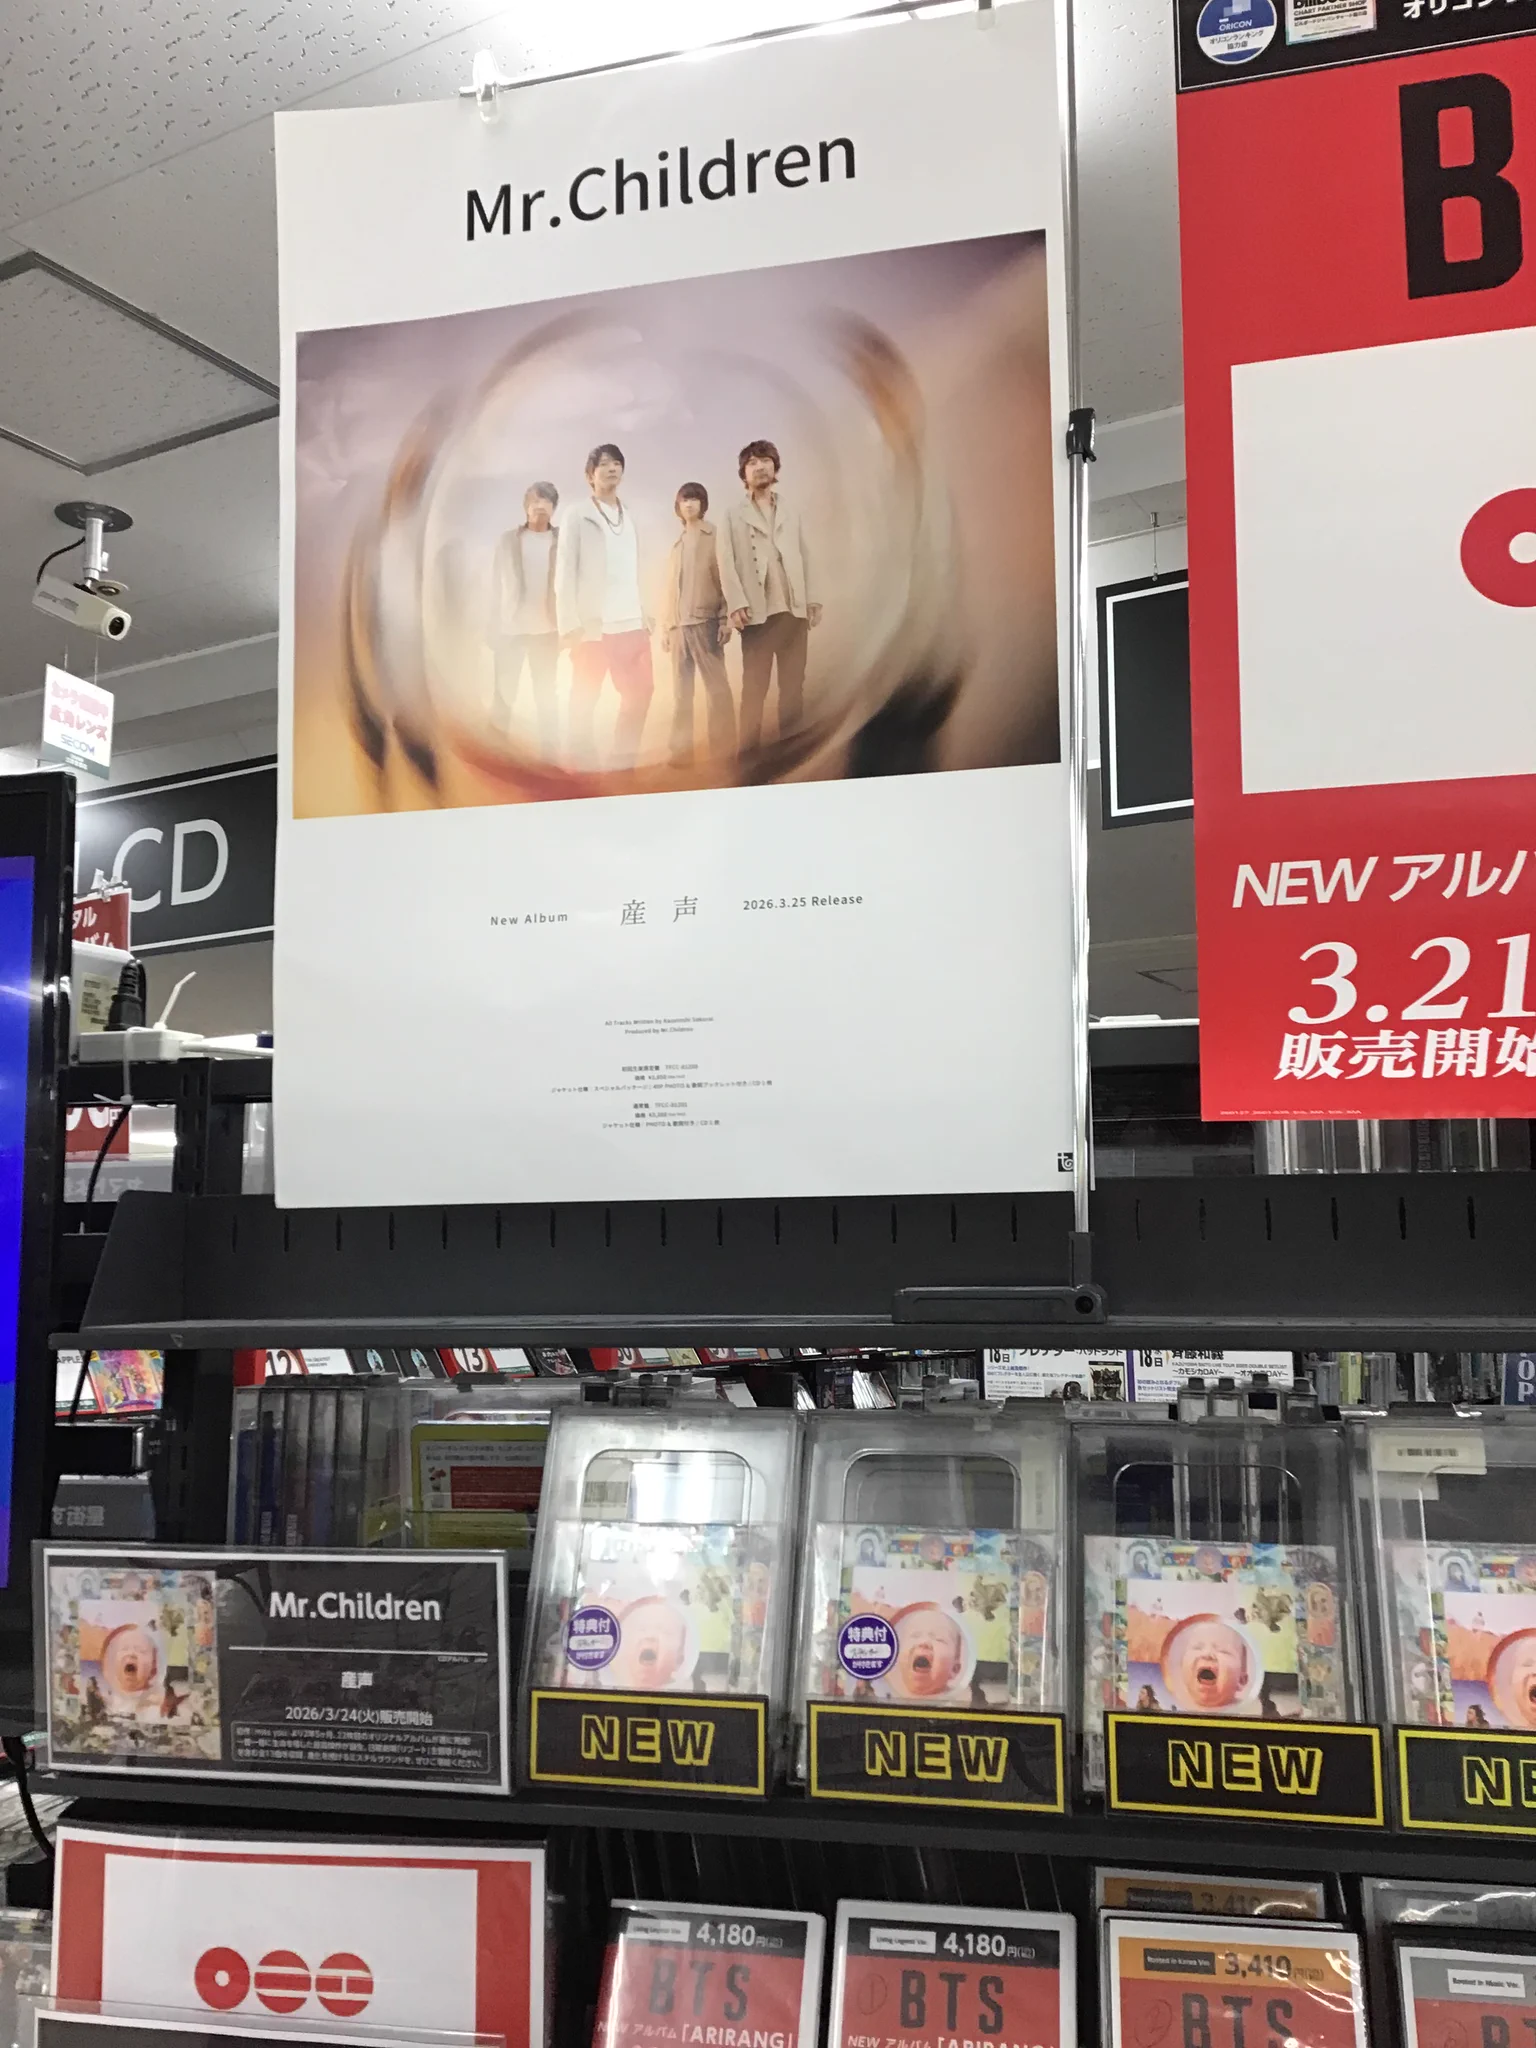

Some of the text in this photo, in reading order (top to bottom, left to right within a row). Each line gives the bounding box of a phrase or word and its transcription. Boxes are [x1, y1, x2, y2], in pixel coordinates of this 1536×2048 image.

[1218, 19, 1253, 31] ORICON
[466, 137, 856, 241] Mr.Children
[1399, 73, 1524, 299] B
[60, 733, 96, 757] SECOM
[1232, 856, 1379, 909] NEW
[490, 915, 519, 927] New
[524, 911, 568, 926] Album
[742, 897, 807, 911] 2026.3.25
[811, 894, 863, 907] Release
[1287, 932, 1536, 1025] 3.21
[1002, 1353, 1011, 1363] 日
[1154, 1357, 1163, 1368] 日
[268, 1590, 442, 1622] Mr.Children
[572, 1617, 611, 1634] 特典付
[847, 1625, 888, 1643] 特典付
[580, 1714, 716, 1767] NEW
[864, 1728, 1010, 1784] NEW
[1167, 1738, 1323, 1796] NEW
[649, 1957, 750, 2023] BTS
[900, 1968, 1005, 2035] BTS
